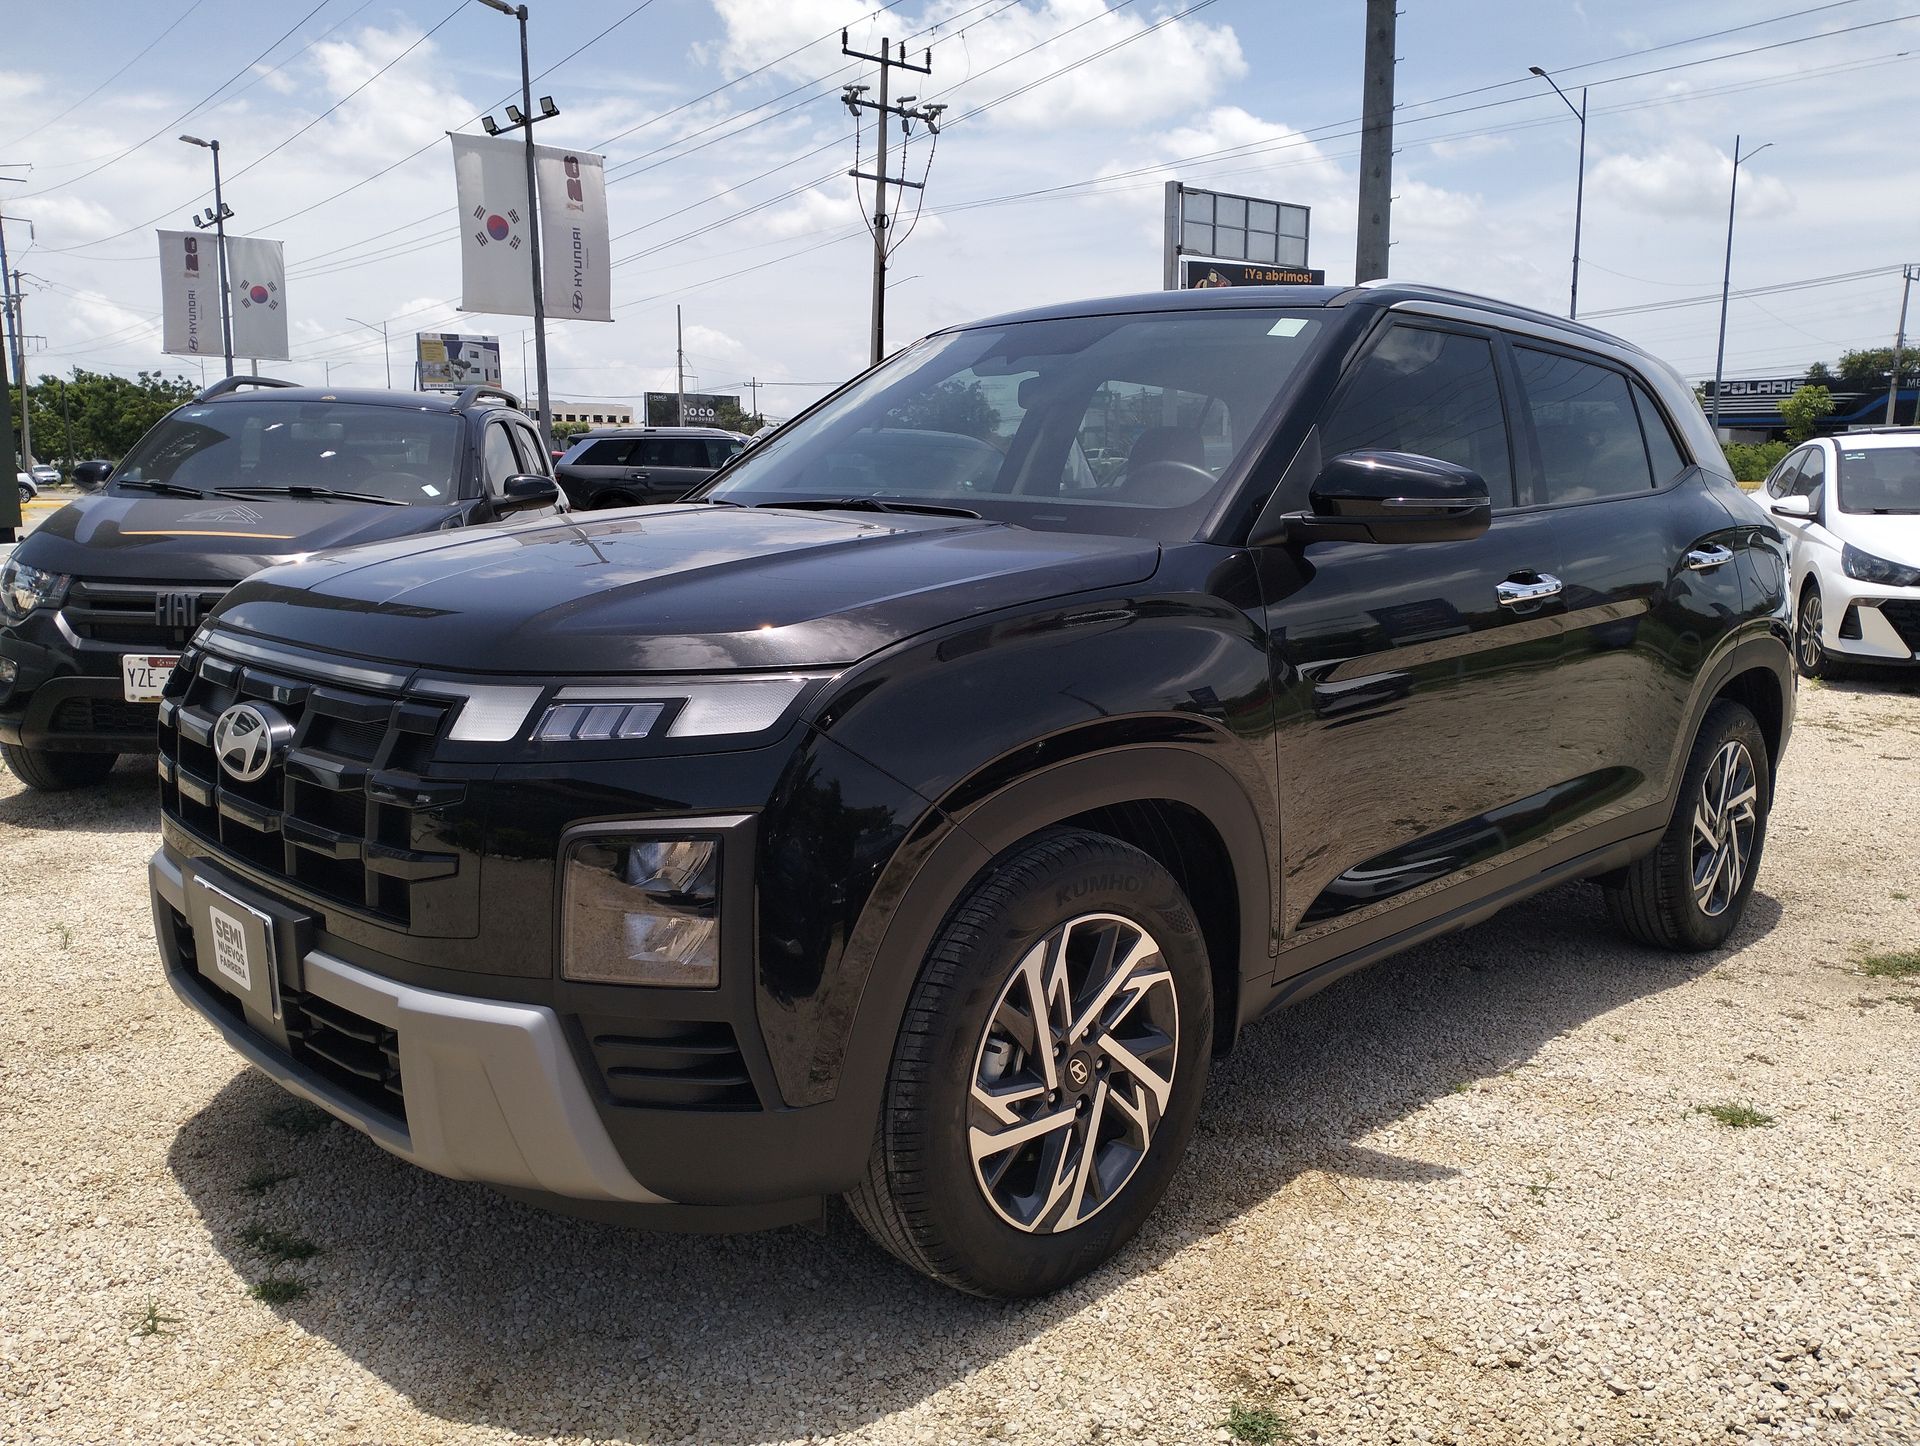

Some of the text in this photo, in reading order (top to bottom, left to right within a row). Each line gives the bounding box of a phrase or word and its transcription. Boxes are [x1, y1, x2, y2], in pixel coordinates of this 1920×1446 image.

[572, 227, 582, 287] HYUNDAI
[1245, 268, 1313, 283] ¡Ya abrimos!
[188, 289, 197, 334] HYUNDAI
[1719, 380, 1805, 394] POLARIS
[155, 592, 202, 626] FIAT
[127, 668, 173, 687] YZE-
[1056, 873, 1140, 906] KUMHO
[214, 917, 244, 951] SEMI
[217, 939, 246, 966] NUEVOS
[219, 954, 248, 980] FARRERA
